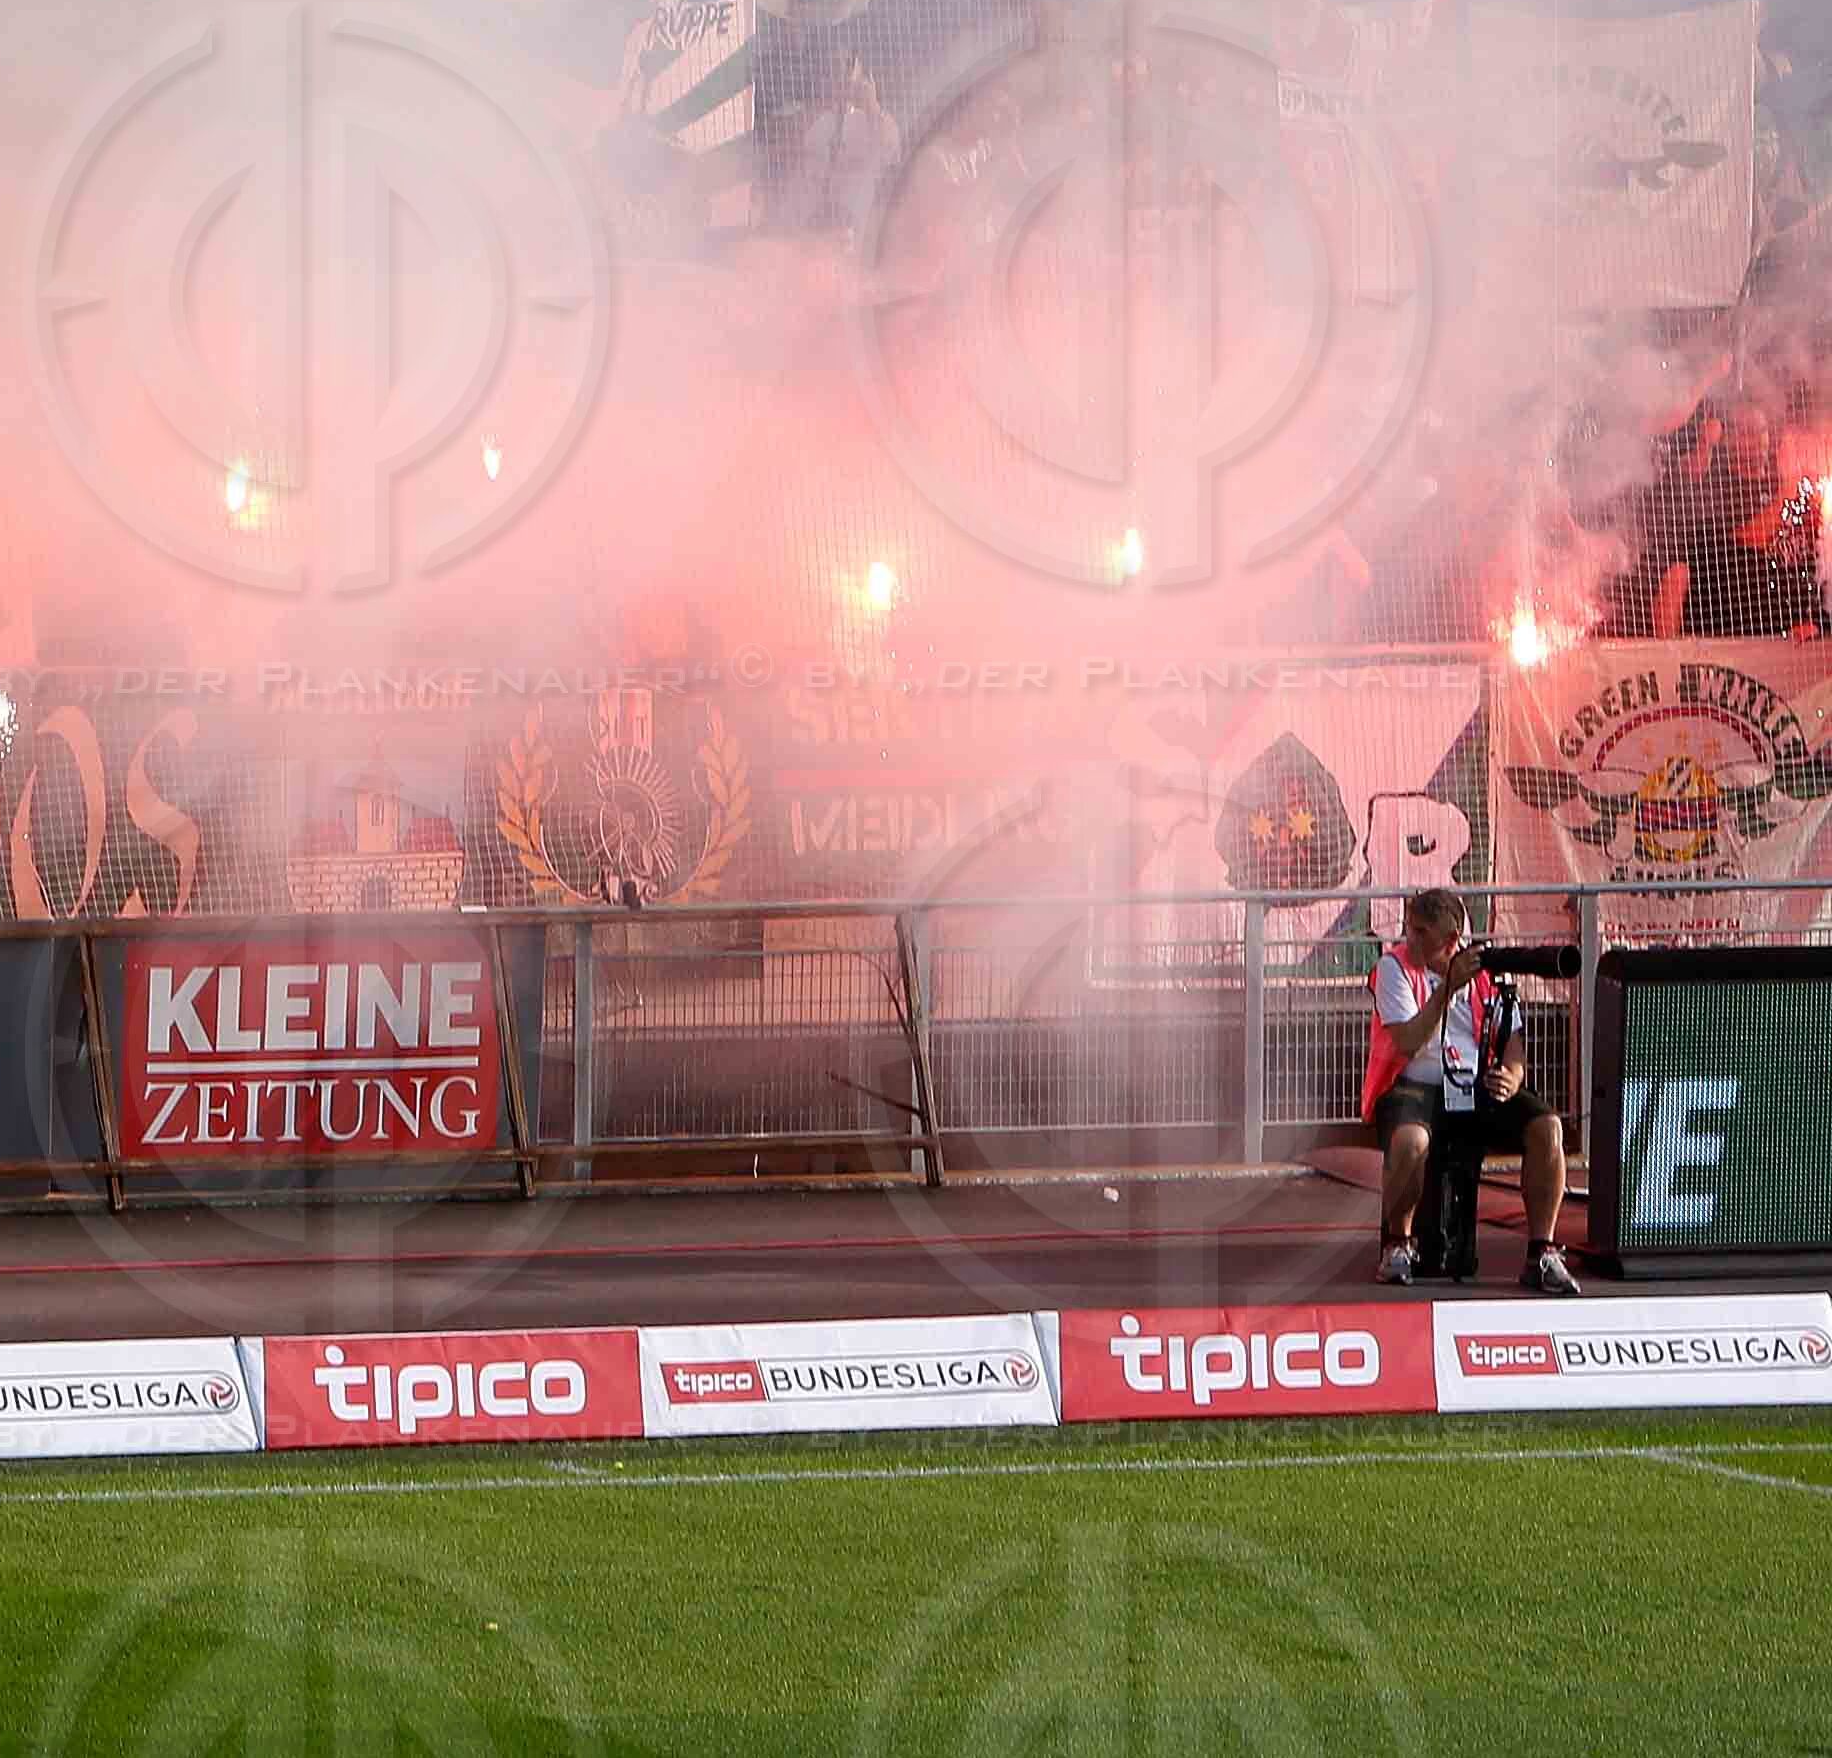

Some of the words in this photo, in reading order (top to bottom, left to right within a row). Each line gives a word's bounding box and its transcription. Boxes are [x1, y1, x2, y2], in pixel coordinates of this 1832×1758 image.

[147, 961, 483, 1055] KLEINE
[141, 1075, 483, 1146] ZEITUNG
[314, 1346, 587, 1435] tipico
[674, 1367, 754, 1399] tipico
[771, 1358, 1002, 1394] BUNDESLIGA
[1111, 1315, 1381, 1406] tipico
[1467, 1338, 1548, 1373] tipico
[1564, 1333, 1798, 1371] BUNDESLIGA
